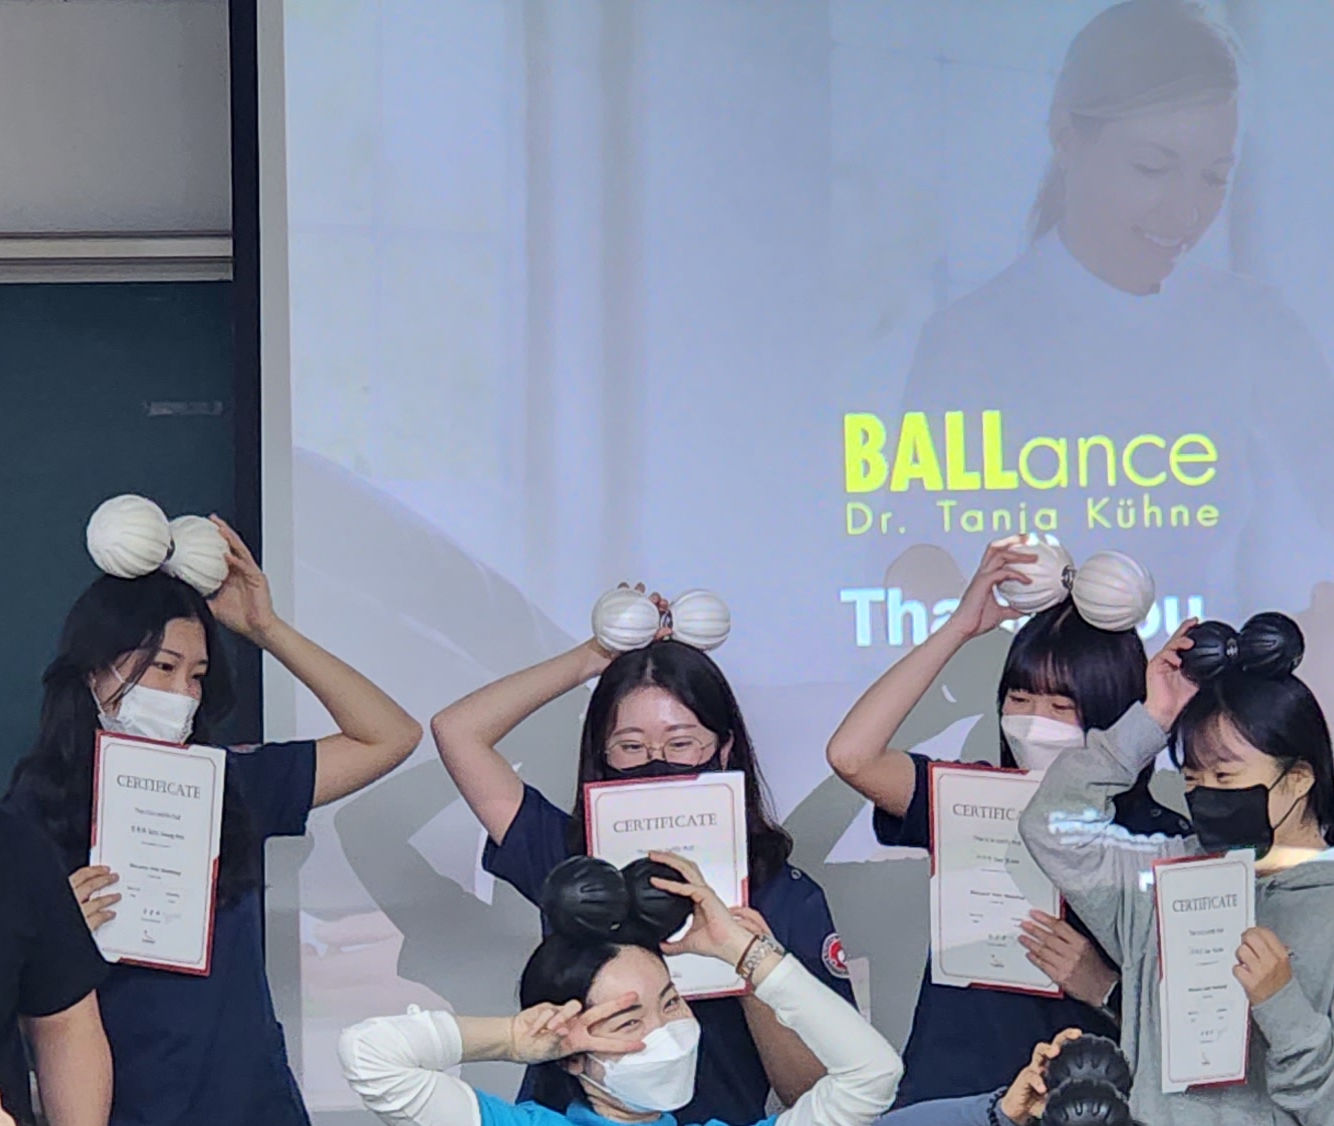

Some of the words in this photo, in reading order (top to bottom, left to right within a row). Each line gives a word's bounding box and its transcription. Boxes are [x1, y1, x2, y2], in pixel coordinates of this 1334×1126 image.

[843, 410, 1218, 492] BALLance
[845, 501, 906, 535] Dr.
[936, 499, 1058, 534] Tanja
[1087, 493, 1220, 531] Kühne
[116, 774, 201, 799] CERTIFICATE
[613, 813, 717, 833] CERTIFICATE
[952, 803, 1019, 822] CERTIFIC
[1172, 893, 1238, 913] CERTIFICATE
